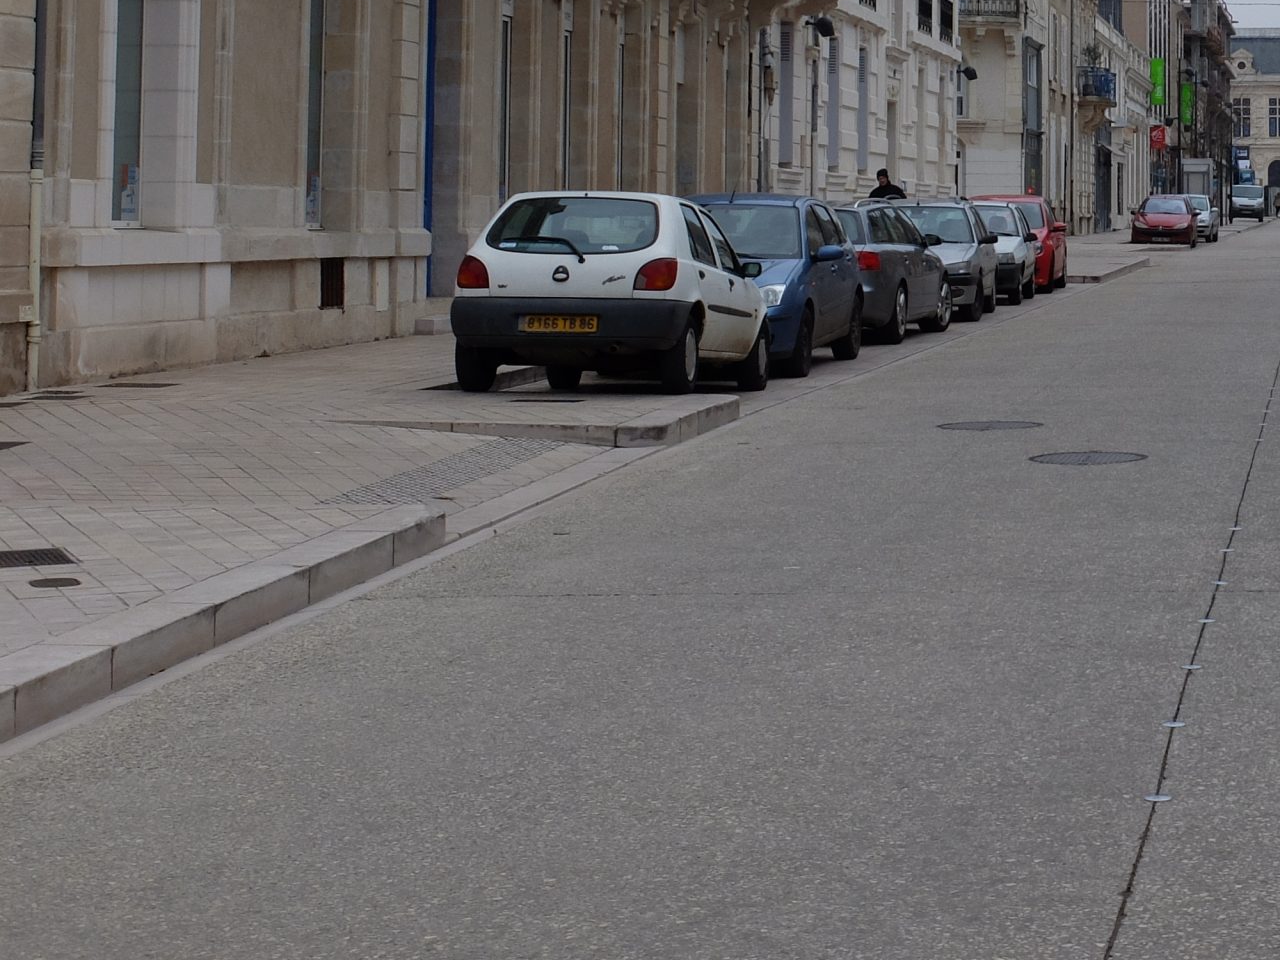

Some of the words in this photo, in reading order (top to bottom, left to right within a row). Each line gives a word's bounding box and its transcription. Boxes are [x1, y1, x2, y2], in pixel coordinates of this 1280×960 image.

[527, 316, 559, 330] 8166
[560, 317, 576, 330] TB
[578, 317, 595, 330] 86
